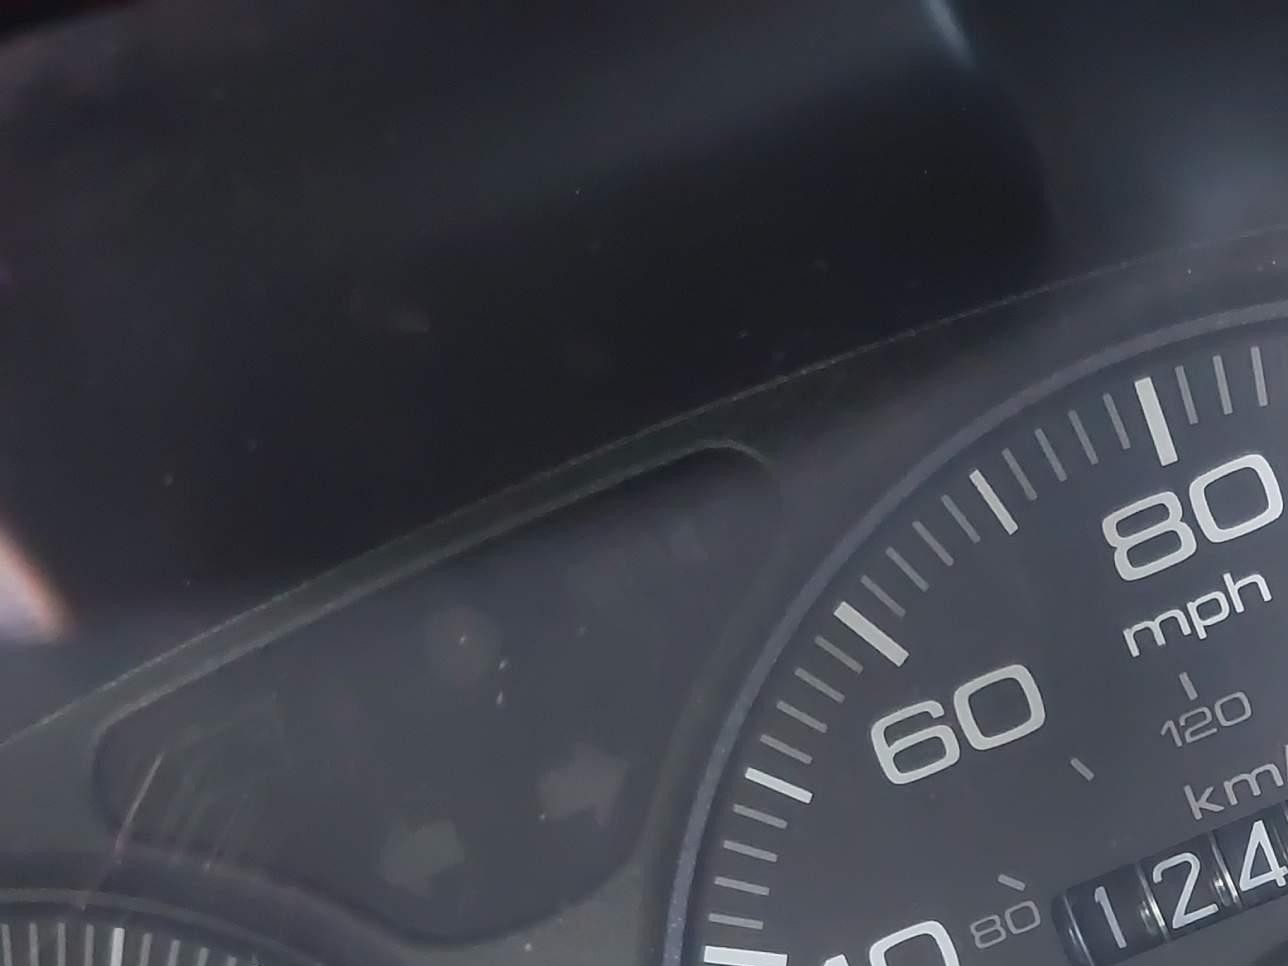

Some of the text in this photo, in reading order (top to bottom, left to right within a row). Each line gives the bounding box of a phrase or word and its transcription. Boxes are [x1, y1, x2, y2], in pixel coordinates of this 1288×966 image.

[1102, 454, 1283, 581] 80
[1123, 573, 1273, 657] mph
[871, 664, 1046, 784] 60
[1160, 692, 1252, 748] 120
[970, 901, 1041, 949] 80
